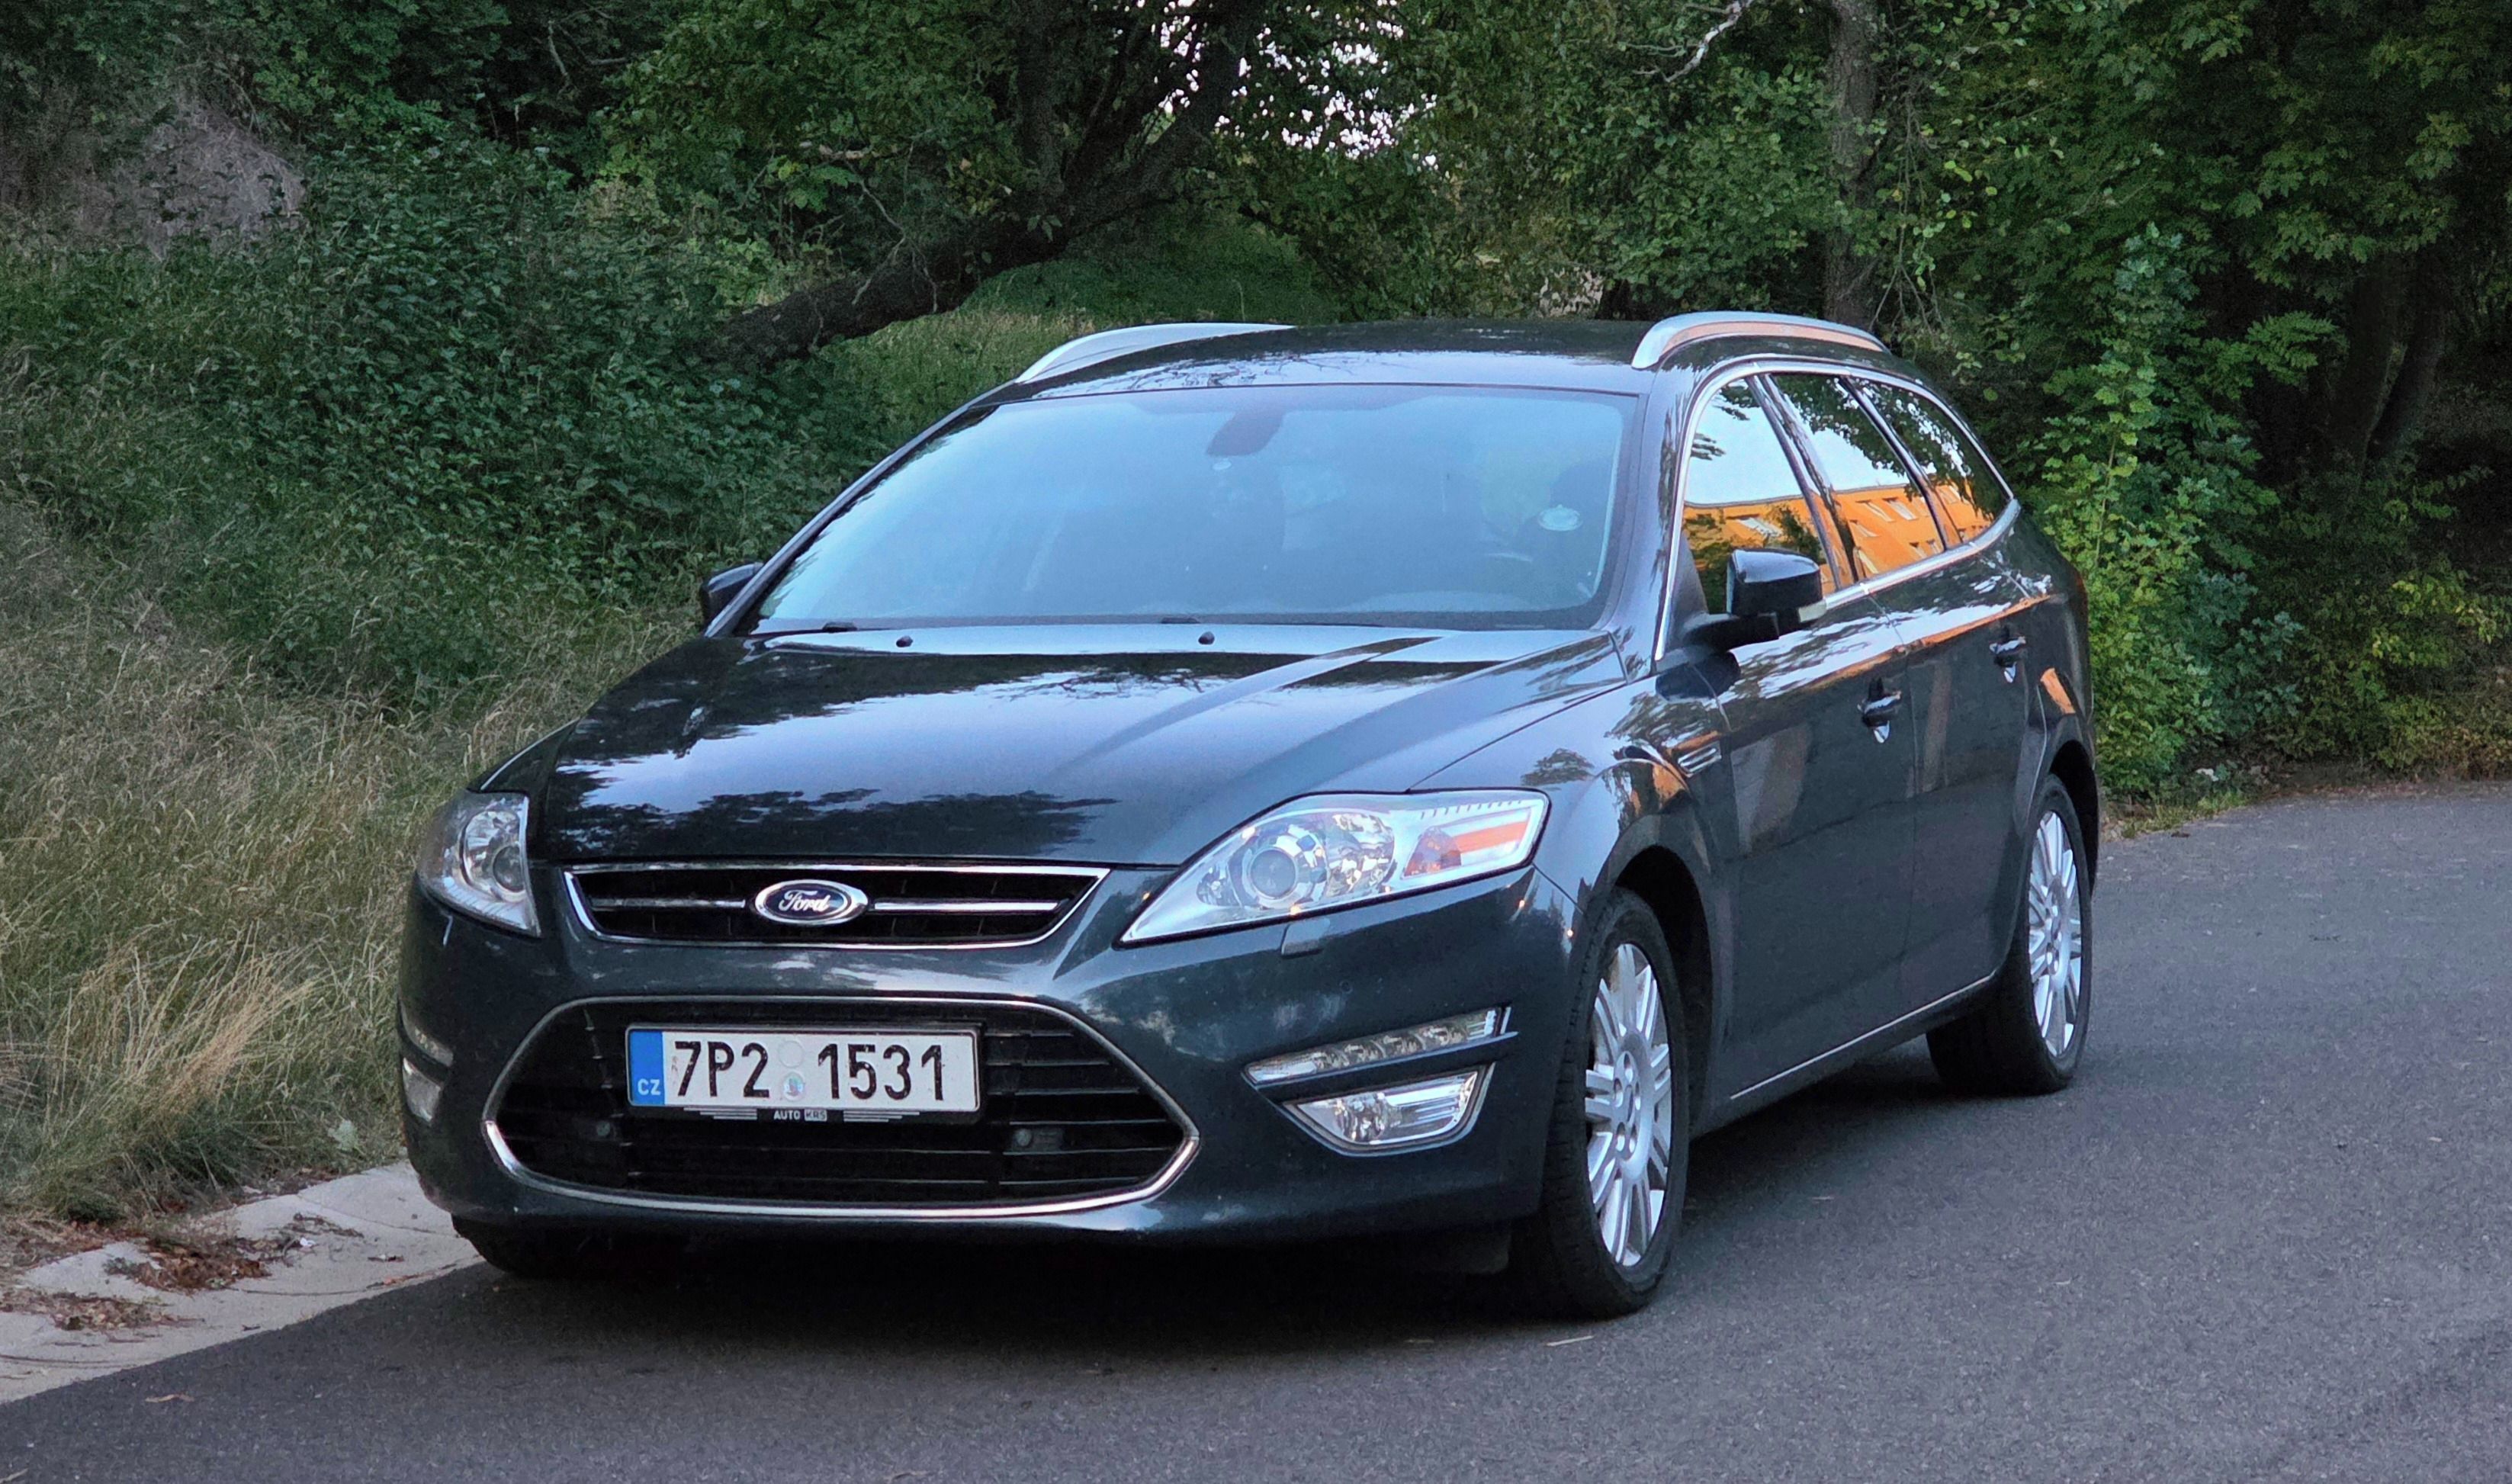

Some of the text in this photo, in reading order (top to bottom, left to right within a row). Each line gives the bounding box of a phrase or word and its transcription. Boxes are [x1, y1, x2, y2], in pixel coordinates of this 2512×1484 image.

[779, 889, 831, 912] Ford
[675, 1041, 943, 1100] 7P2 1531
[638, 1078, 660, 1096] CZ
[773, 1110, 801, 1120] AUTO
